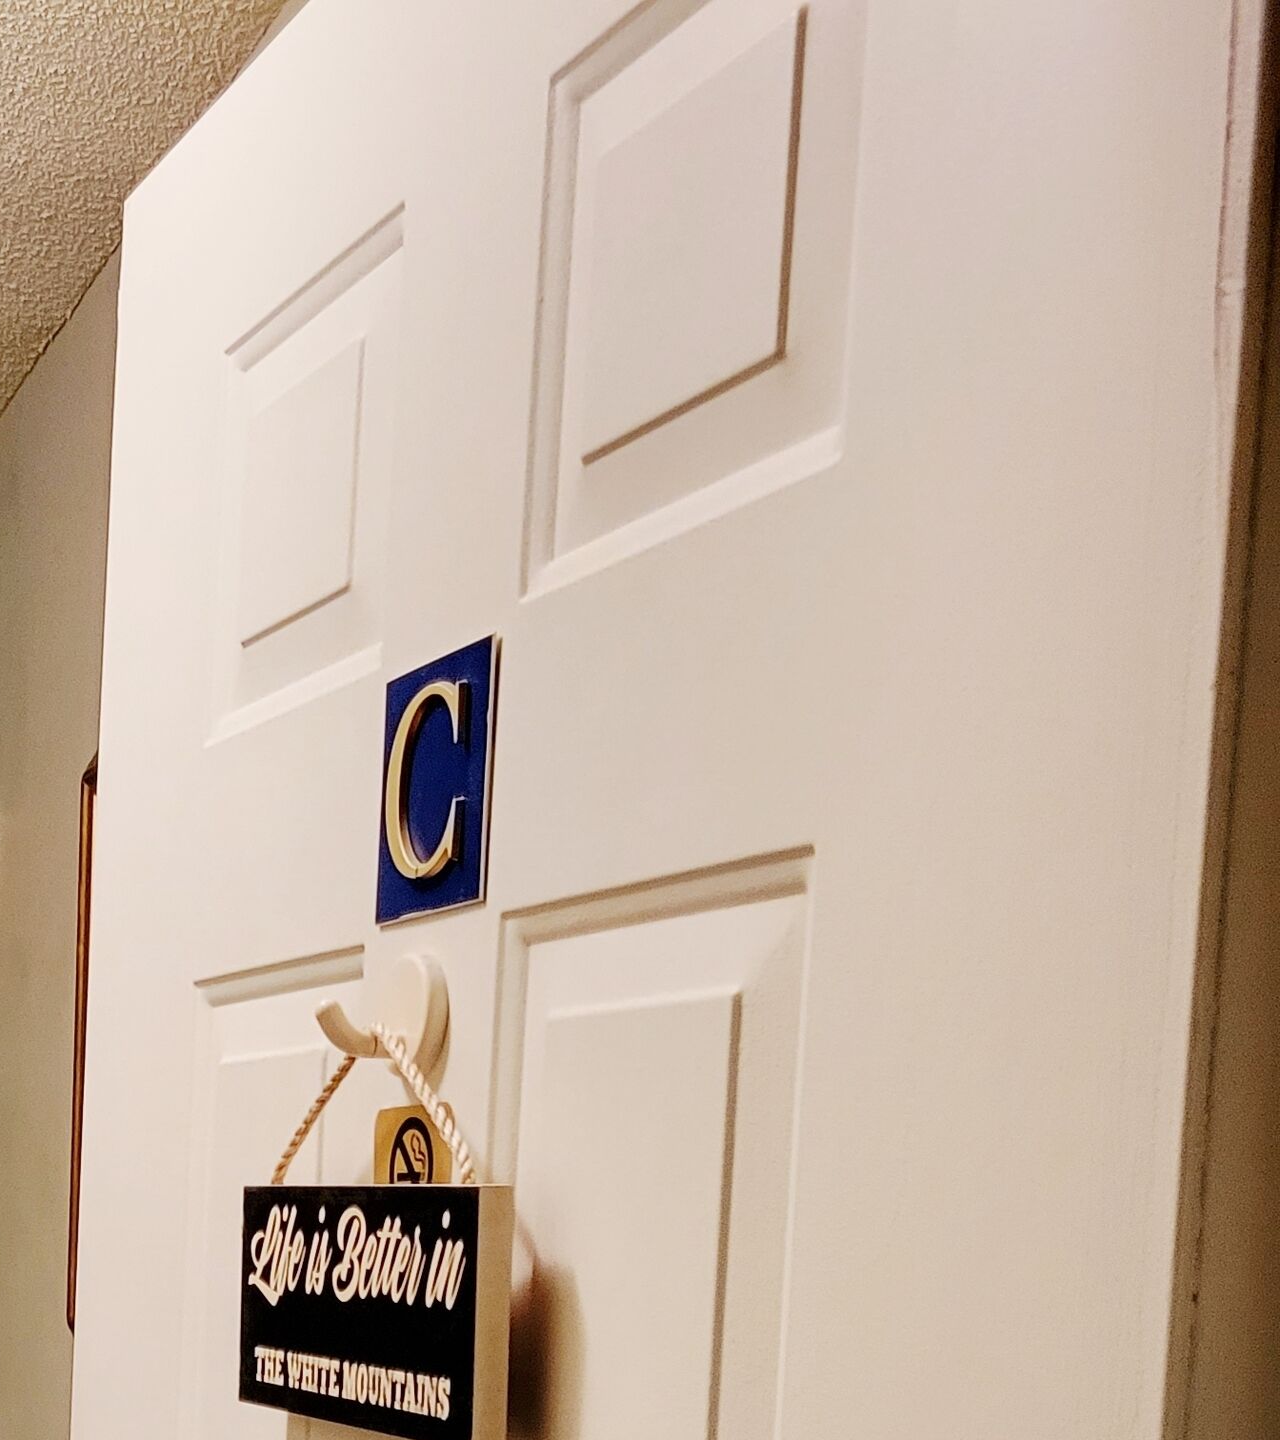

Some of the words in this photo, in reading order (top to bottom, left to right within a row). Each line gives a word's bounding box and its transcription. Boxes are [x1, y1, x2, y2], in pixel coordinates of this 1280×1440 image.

[385, 680, 466, 879] C
[248, 1203, 307, 1307] Life
[305, 1205, 333, 1296] is
[331, 1203, 427, 1306] Better
[424, 1208, 467, 1311] in
[254, 1345, 285, 1387] THE
[286, 1351, 340, 1398] WHITE
[341, 1359, 452, 1421] MOUNTAINS
